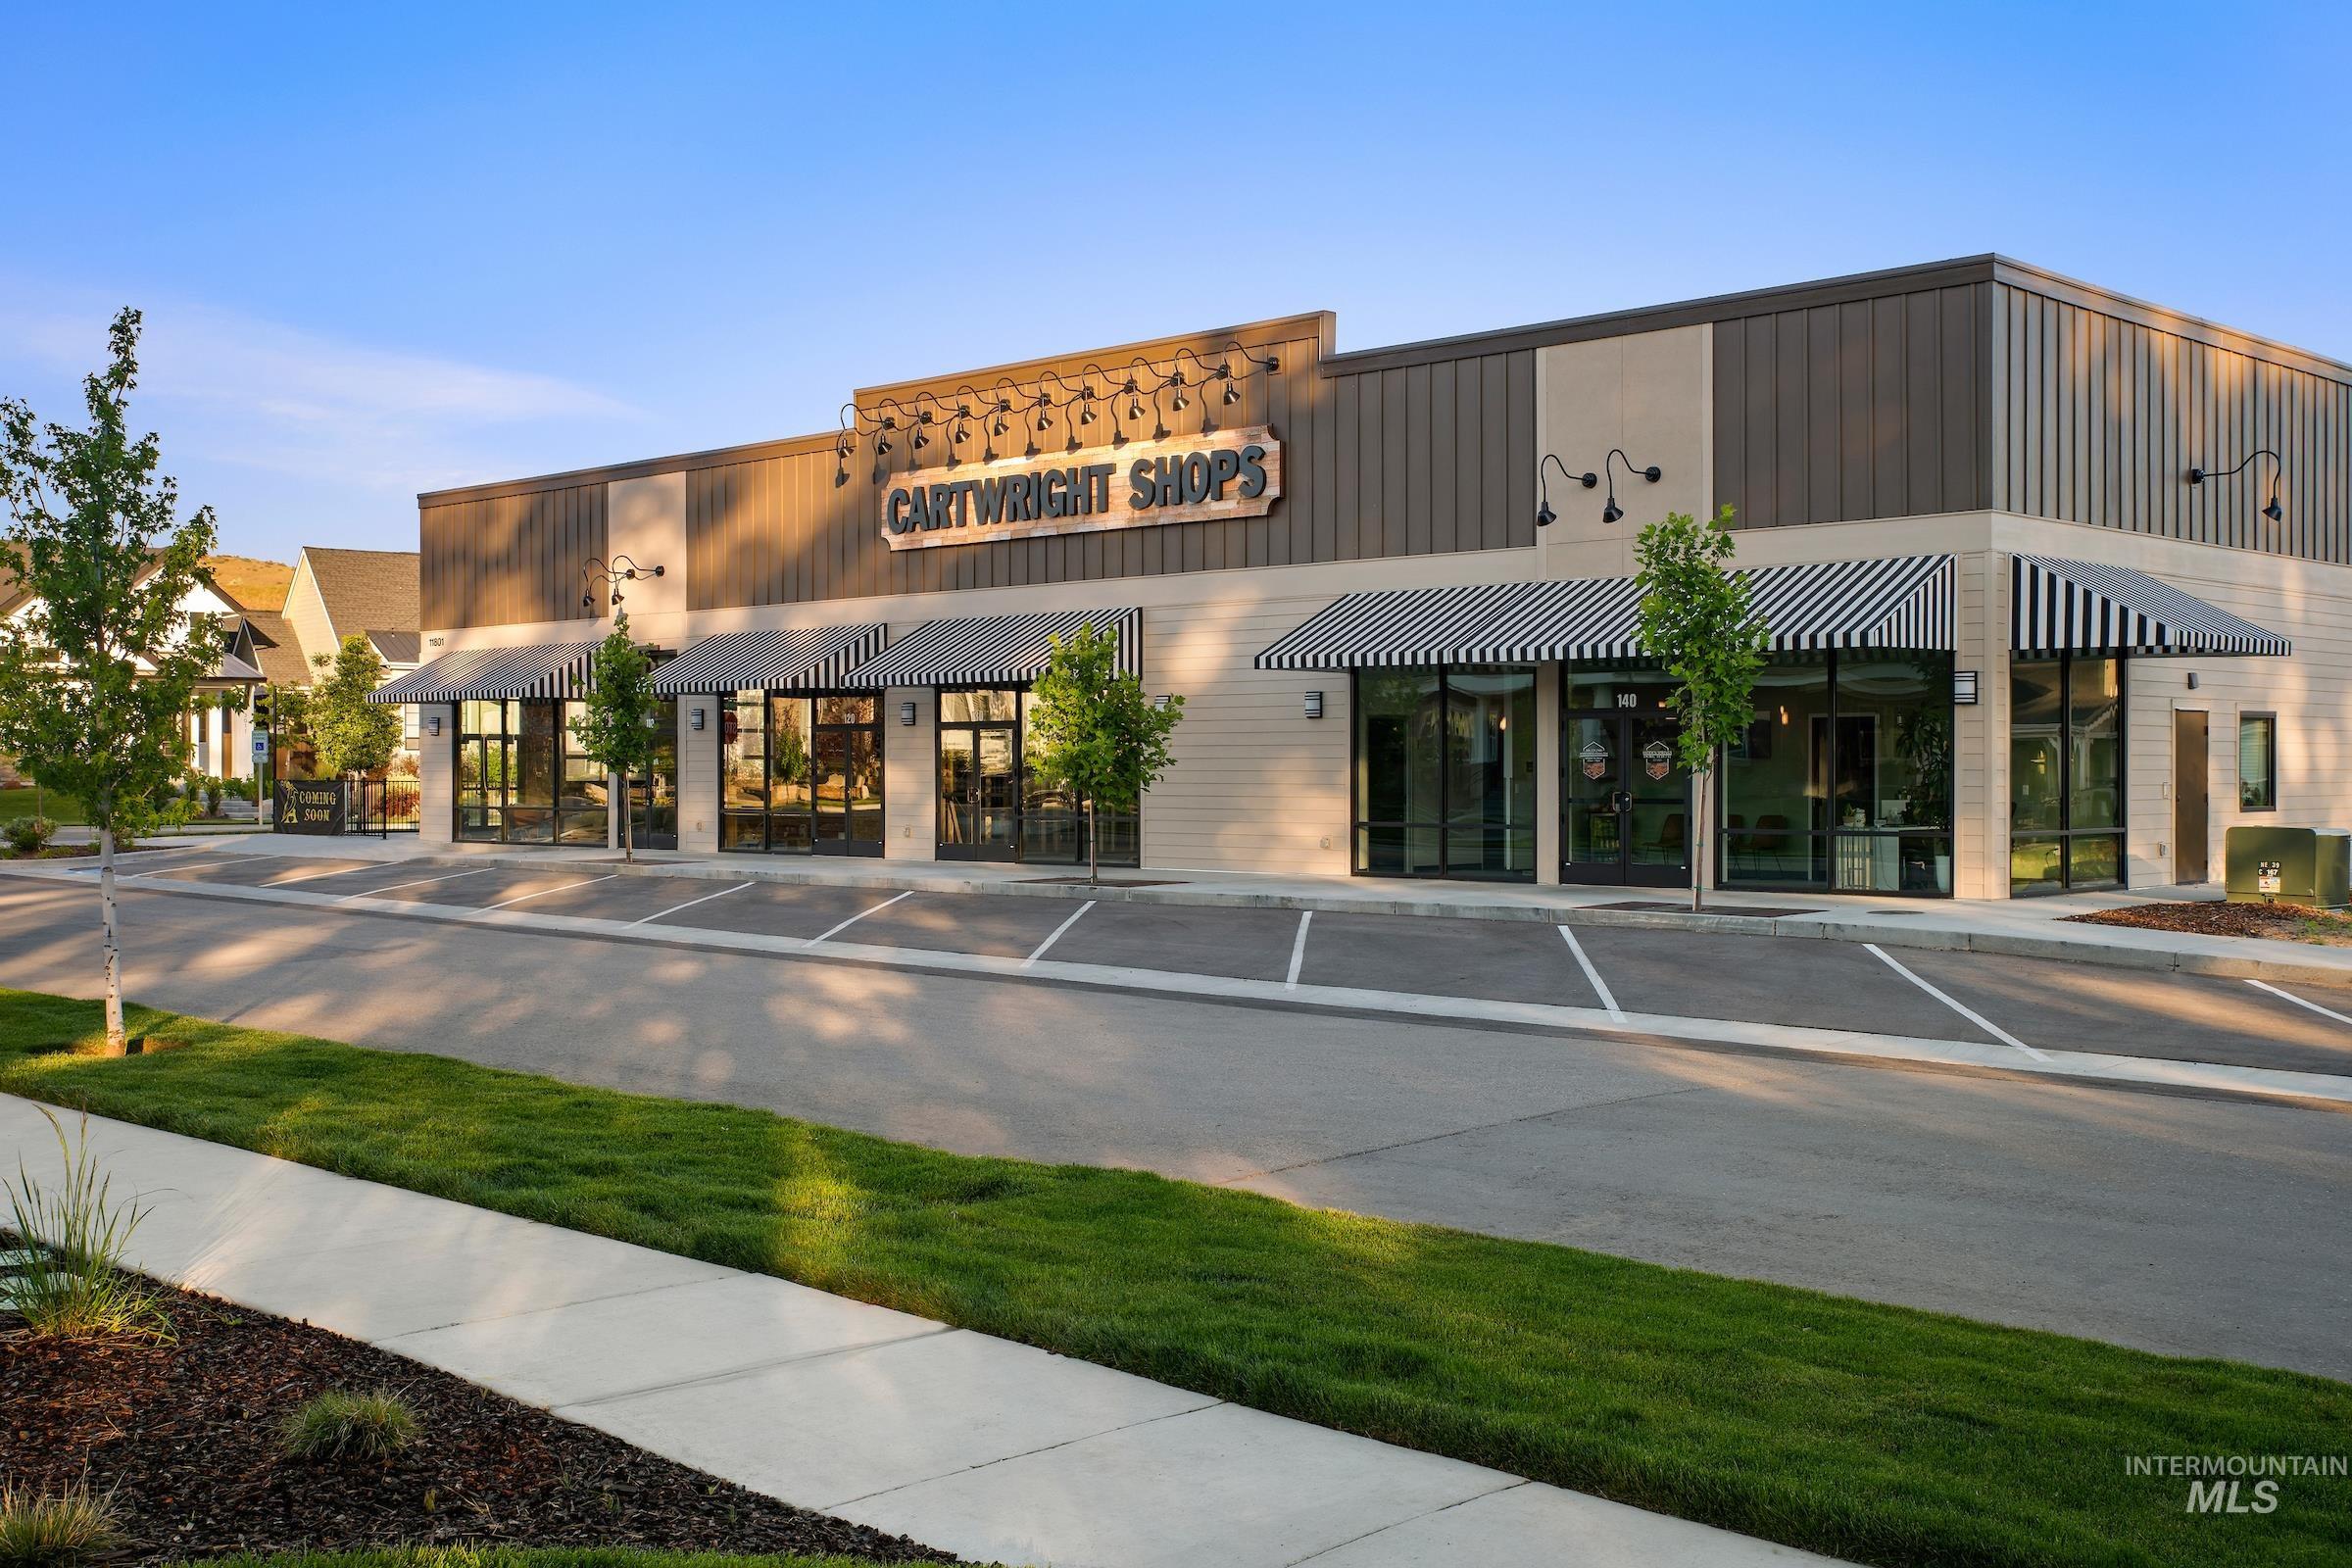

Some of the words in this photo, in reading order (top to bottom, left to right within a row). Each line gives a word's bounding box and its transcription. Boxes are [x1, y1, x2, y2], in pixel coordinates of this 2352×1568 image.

[887, 463, 1116, 534] CARTWRIGHT
[1128, 445, 1266, 511] SHOPS
[429, 637, 444, 647] 11801
[1617, 693, 1637, 708] 140
[844, 713, 856, 724] 120
[299, 791, 336, 806] COMING
[305, 808, 329, 821] SOON
